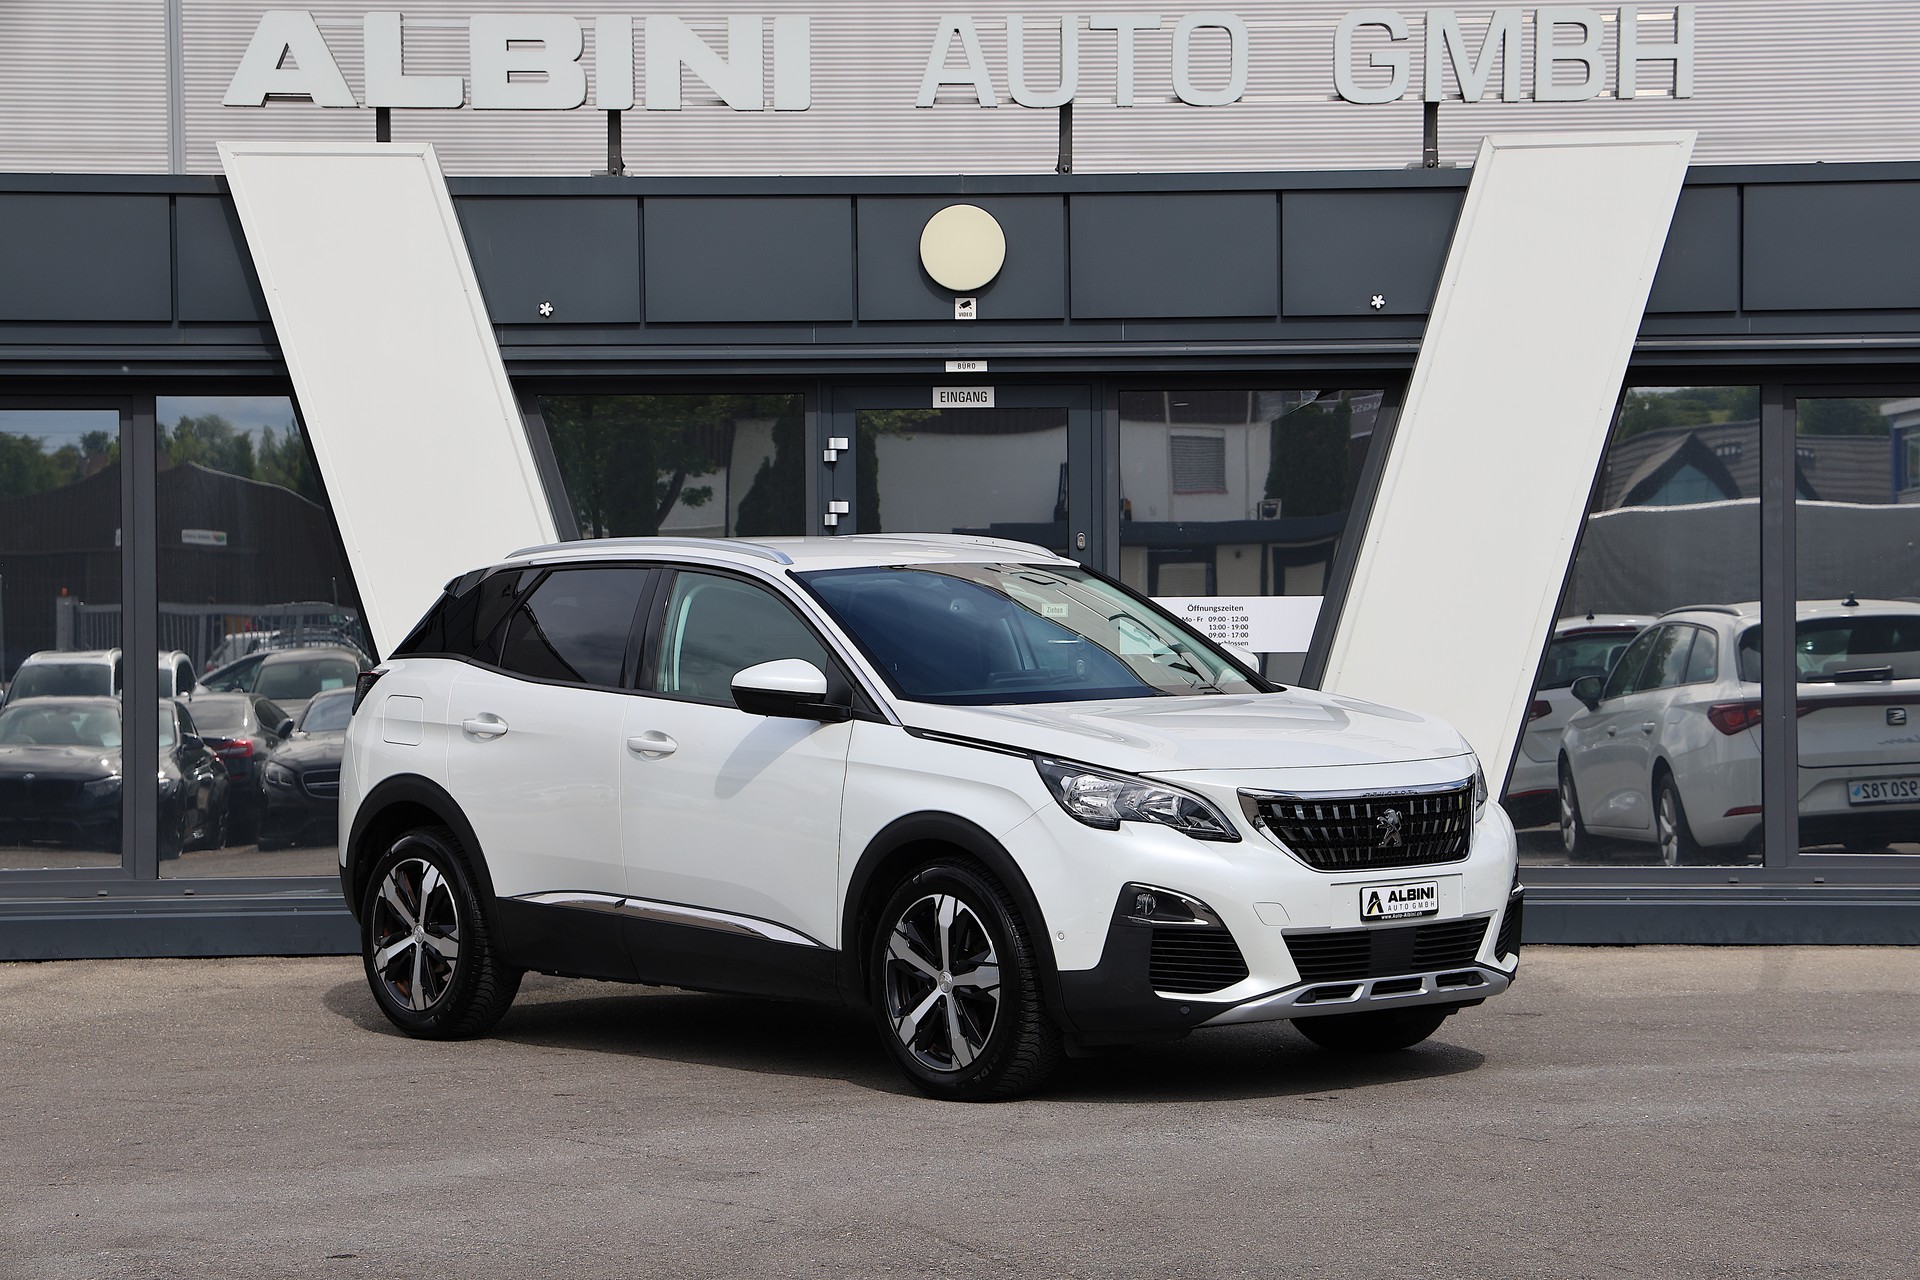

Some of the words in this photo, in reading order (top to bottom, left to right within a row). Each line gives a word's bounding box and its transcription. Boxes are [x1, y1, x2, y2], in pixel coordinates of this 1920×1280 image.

[222, 10, 811, 112] ALBINI
[915, 11, 1249, 108] AUTO
[1333, 5, 1695, 104] GMBH
[957, 361, 976, 369] BÜRO
[940, 391, 988, 403] EINGANG
[1187, 604, 1244, 613] Öffnungszeiten
[1387, 886, 1435, 903] ALBINI
[1387, 903, 1409, 912] AUTO
[1412, 901, 1435, 909] GMBH
